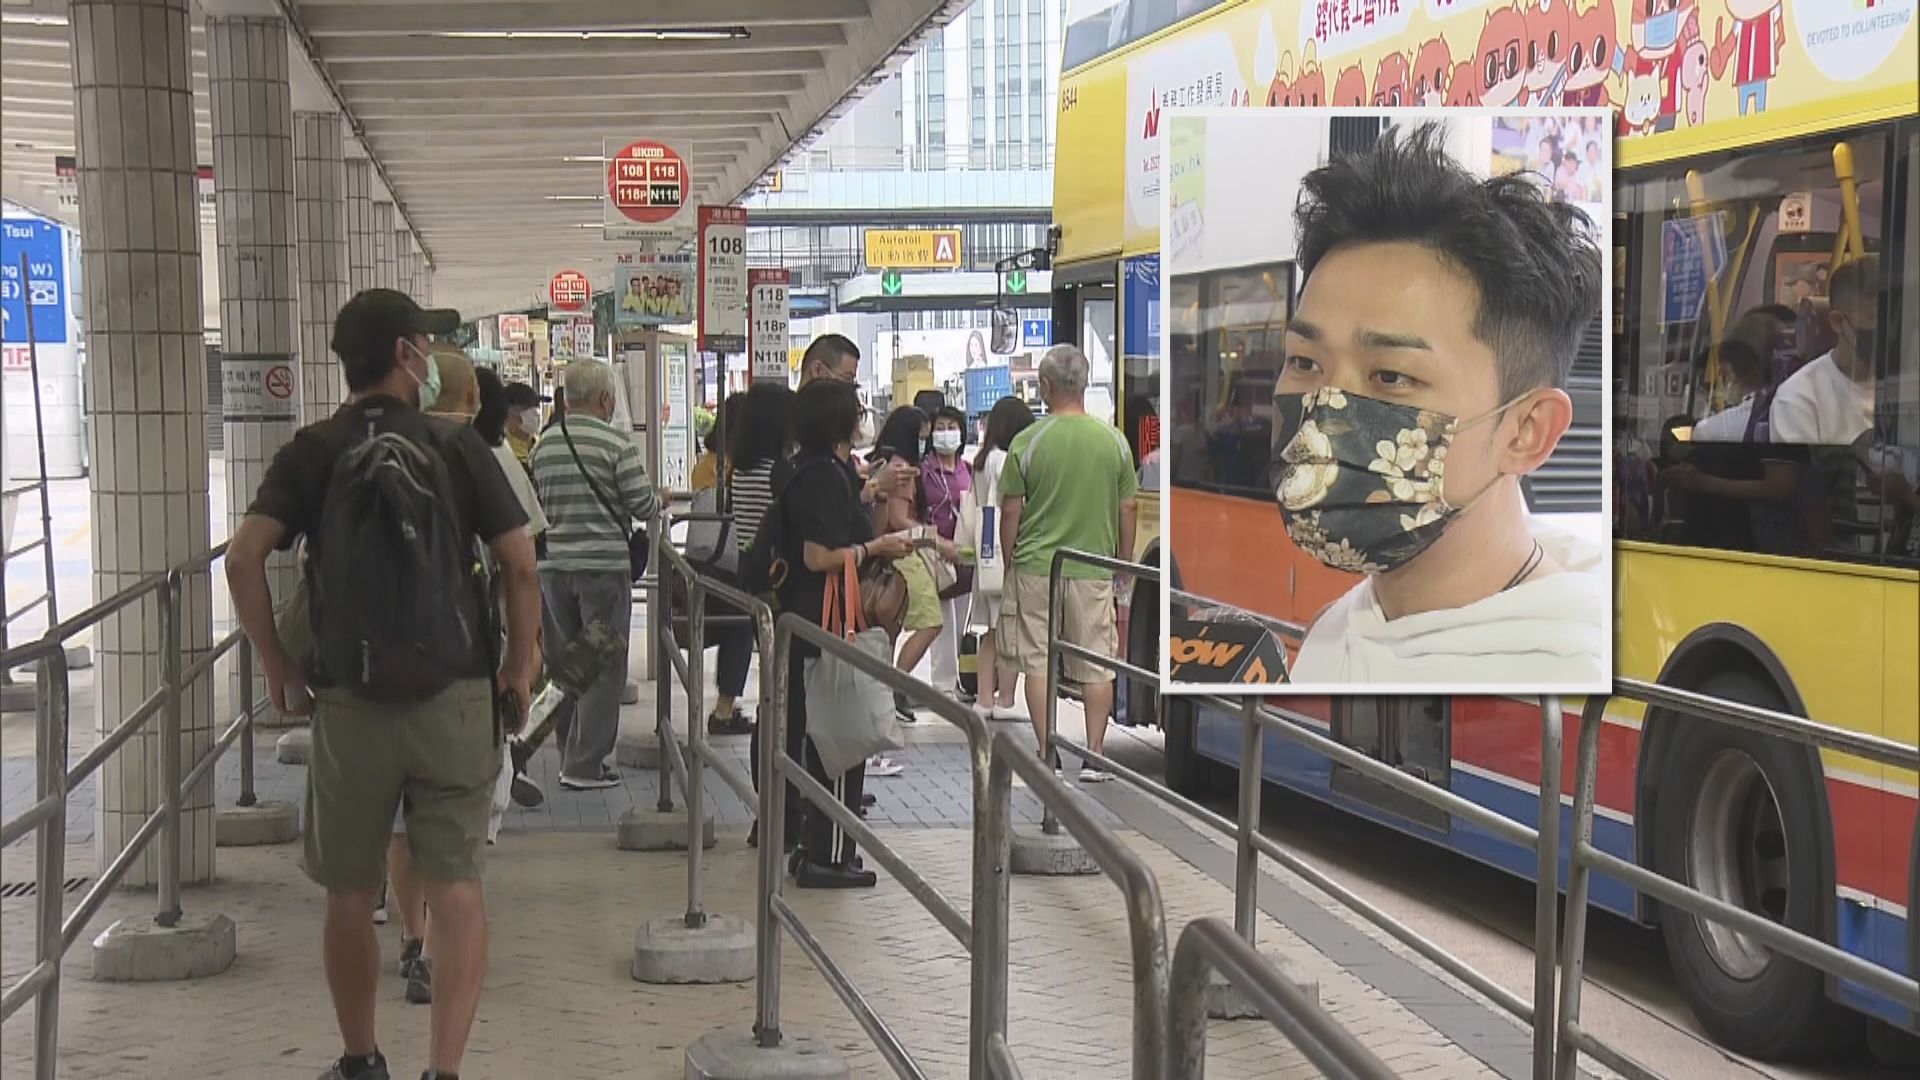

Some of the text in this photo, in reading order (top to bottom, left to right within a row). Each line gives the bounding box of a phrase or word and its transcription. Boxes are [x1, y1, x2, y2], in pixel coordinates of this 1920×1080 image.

[1806, 8, 1910, 48] DEVOTED TO VOLUNTEERING
[621, 164, 675, 178] 108 118
[620, 188, 679, 200] 118P N118
[4, 224, 34, 238] Tsui
[709, 236, 743, 254] 108
[879, 234, 921, 245] Autotoll
[757, 288, 784, 302] 118
[754, 320, 787, 332] 118P
[754, 350, 787, 363] N118
